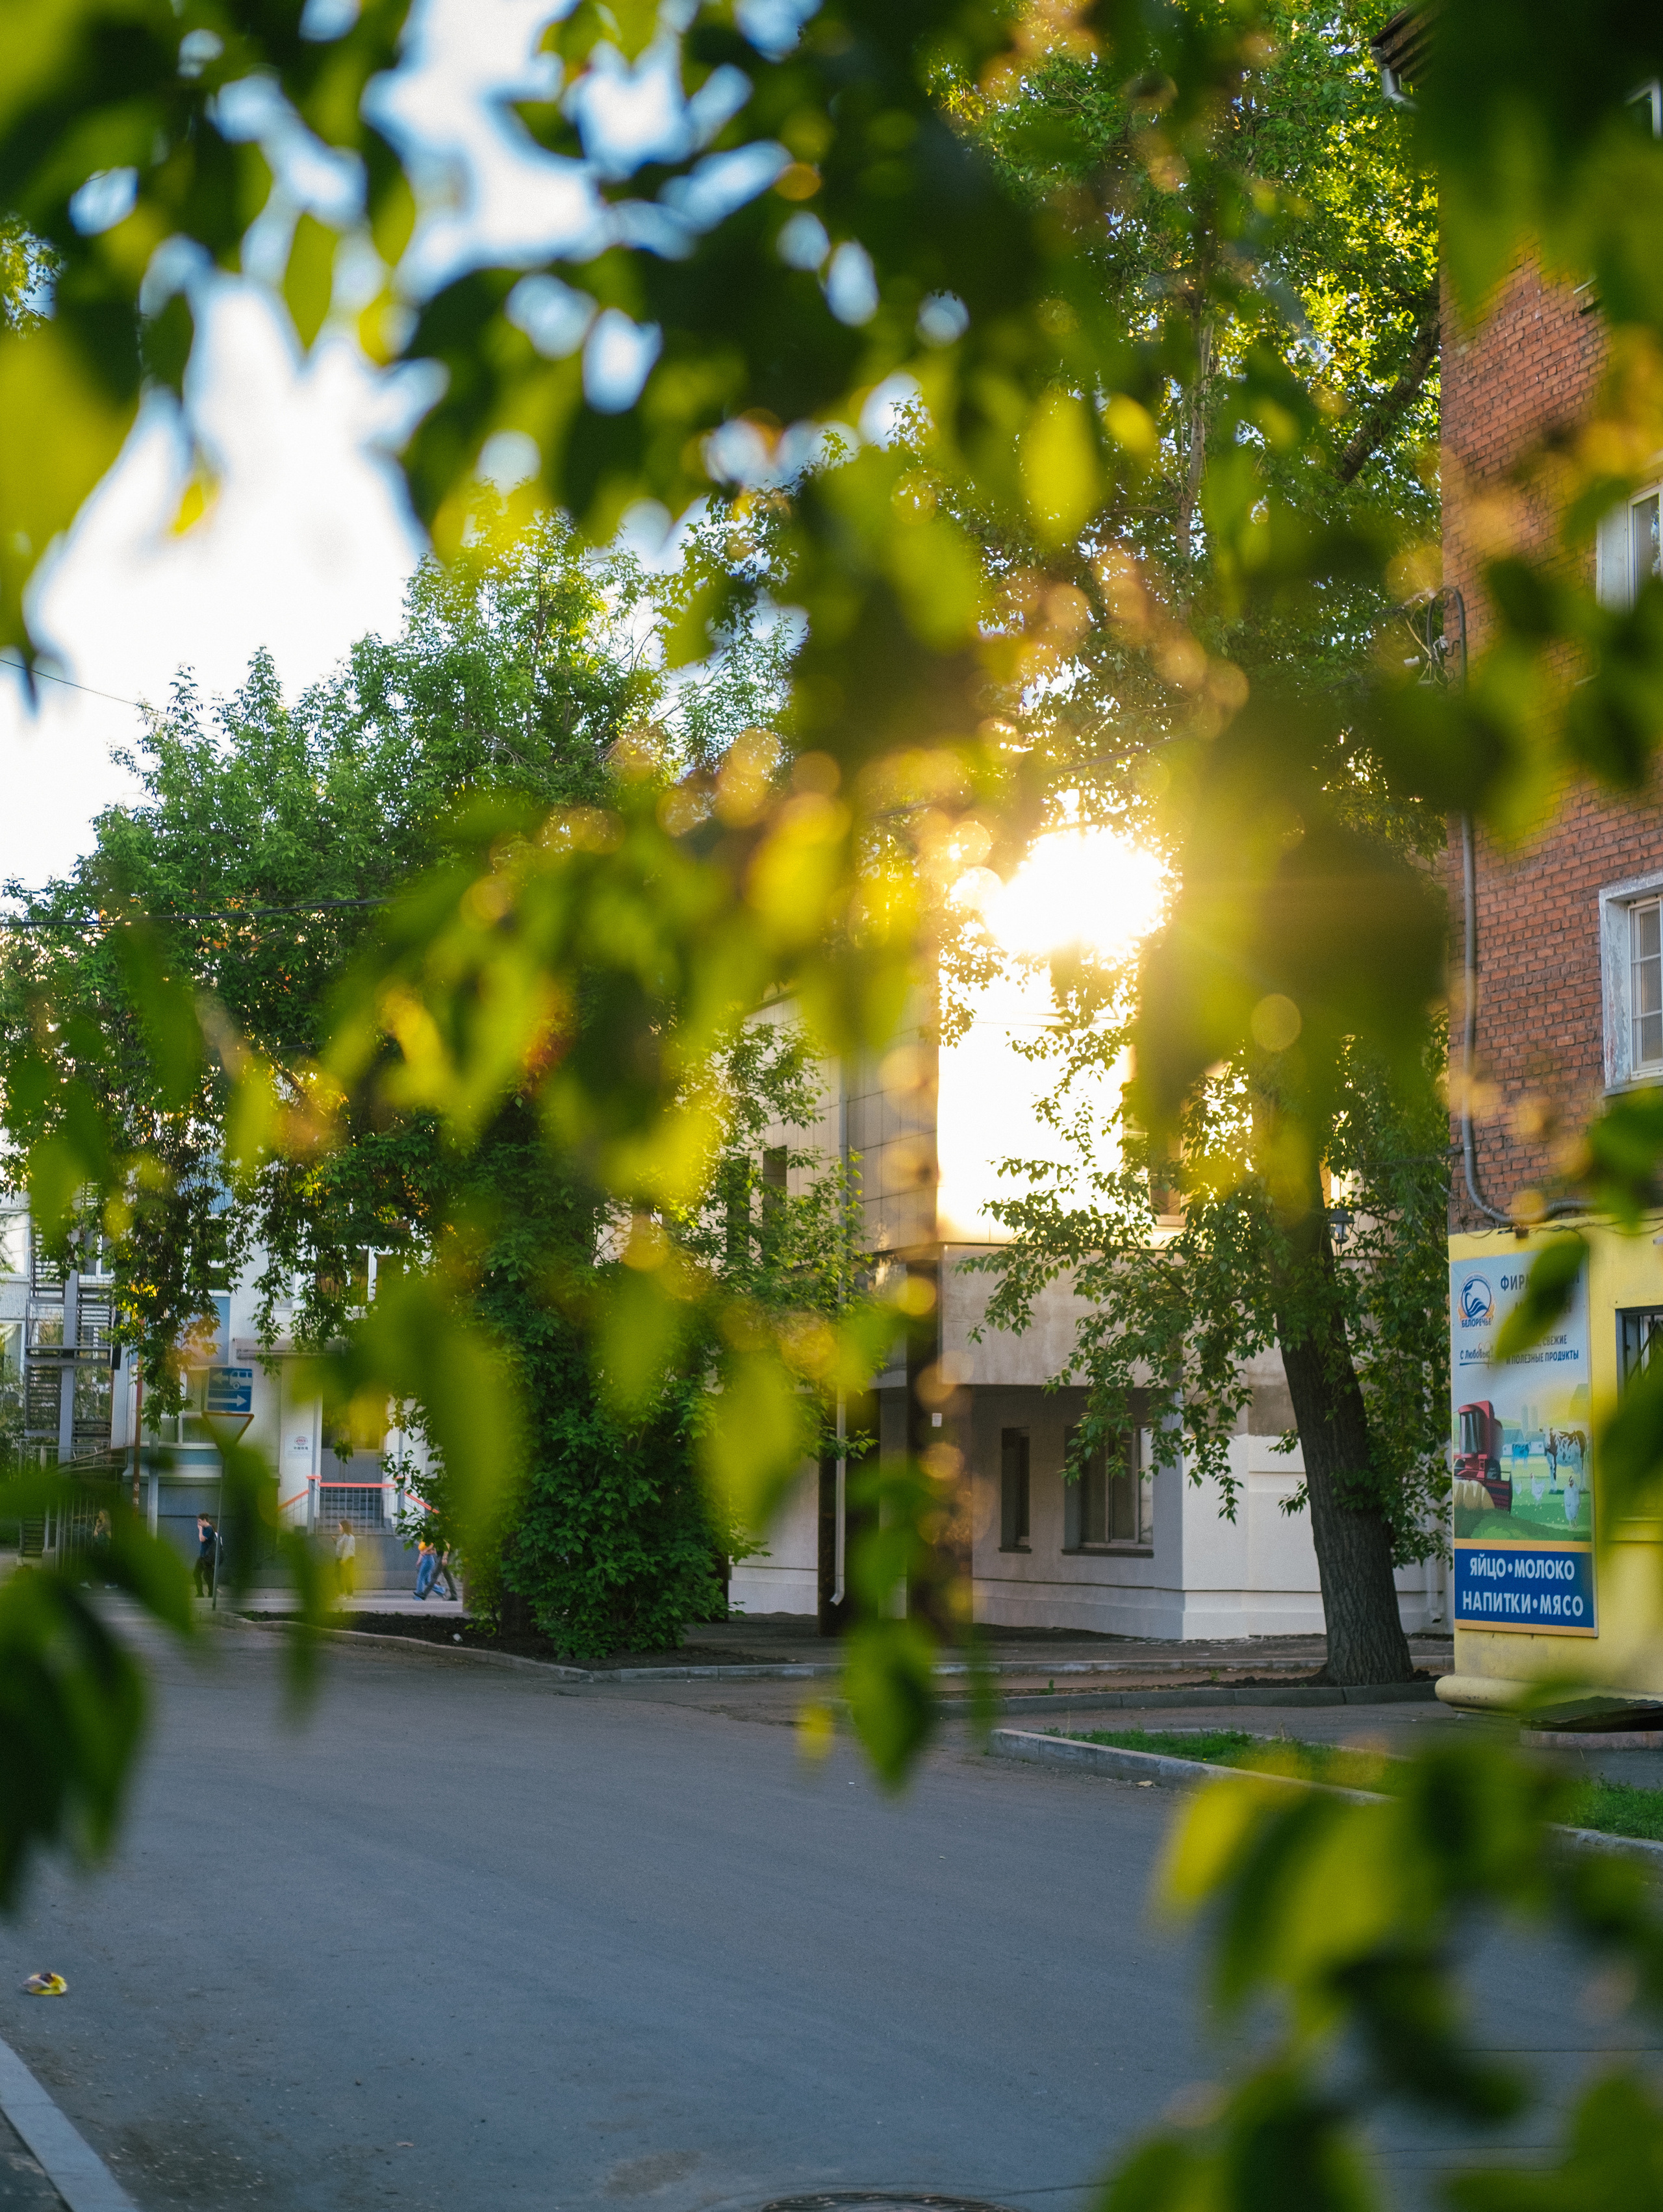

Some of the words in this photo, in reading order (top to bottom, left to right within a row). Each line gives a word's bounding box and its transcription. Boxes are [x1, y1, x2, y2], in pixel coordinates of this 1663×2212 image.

[1462, 1318, 1492, 1328] БЕЛОРЕЧЬЕ
[1542, 1334, 1568, 1346] СВЕЖИЕ
[1460, 1350, 1464, 1360] С
[1512, 1353, 1543, 1364] ПОЛЕЗНЫЕ
[1545, 1349, 1579, 1362] ПРОДУКТЫ
